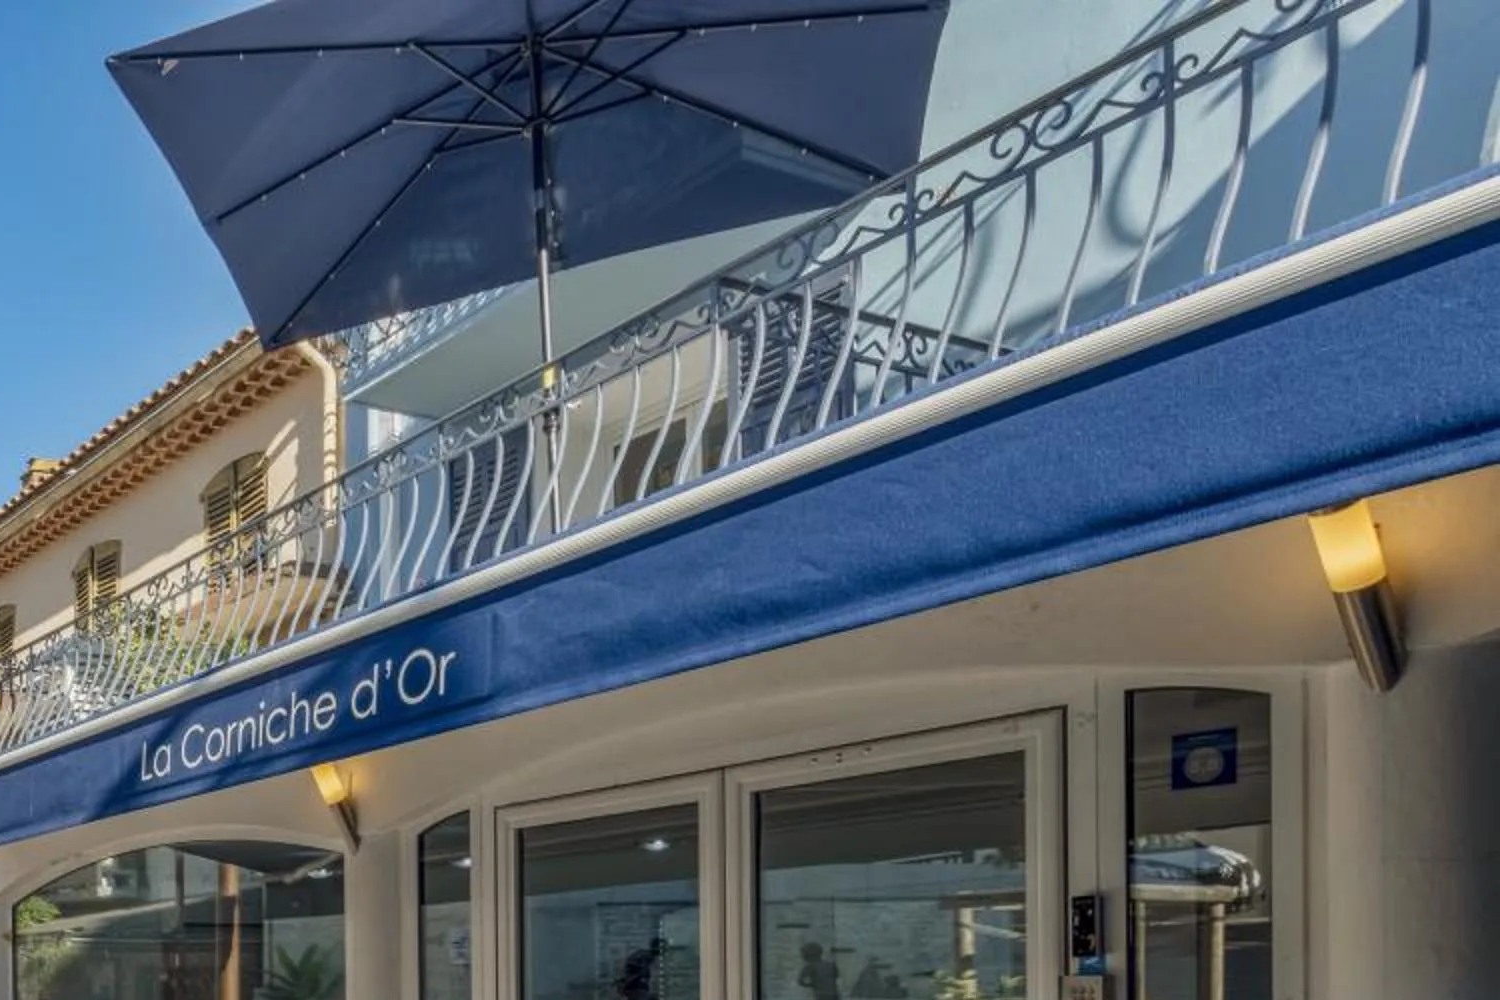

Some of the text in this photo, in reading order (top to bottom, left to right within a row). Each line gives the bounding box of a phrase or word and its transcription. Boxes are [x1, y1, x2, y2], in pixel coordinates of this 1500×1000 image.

[141, 648, 456, 782] La Corniche d'Or
